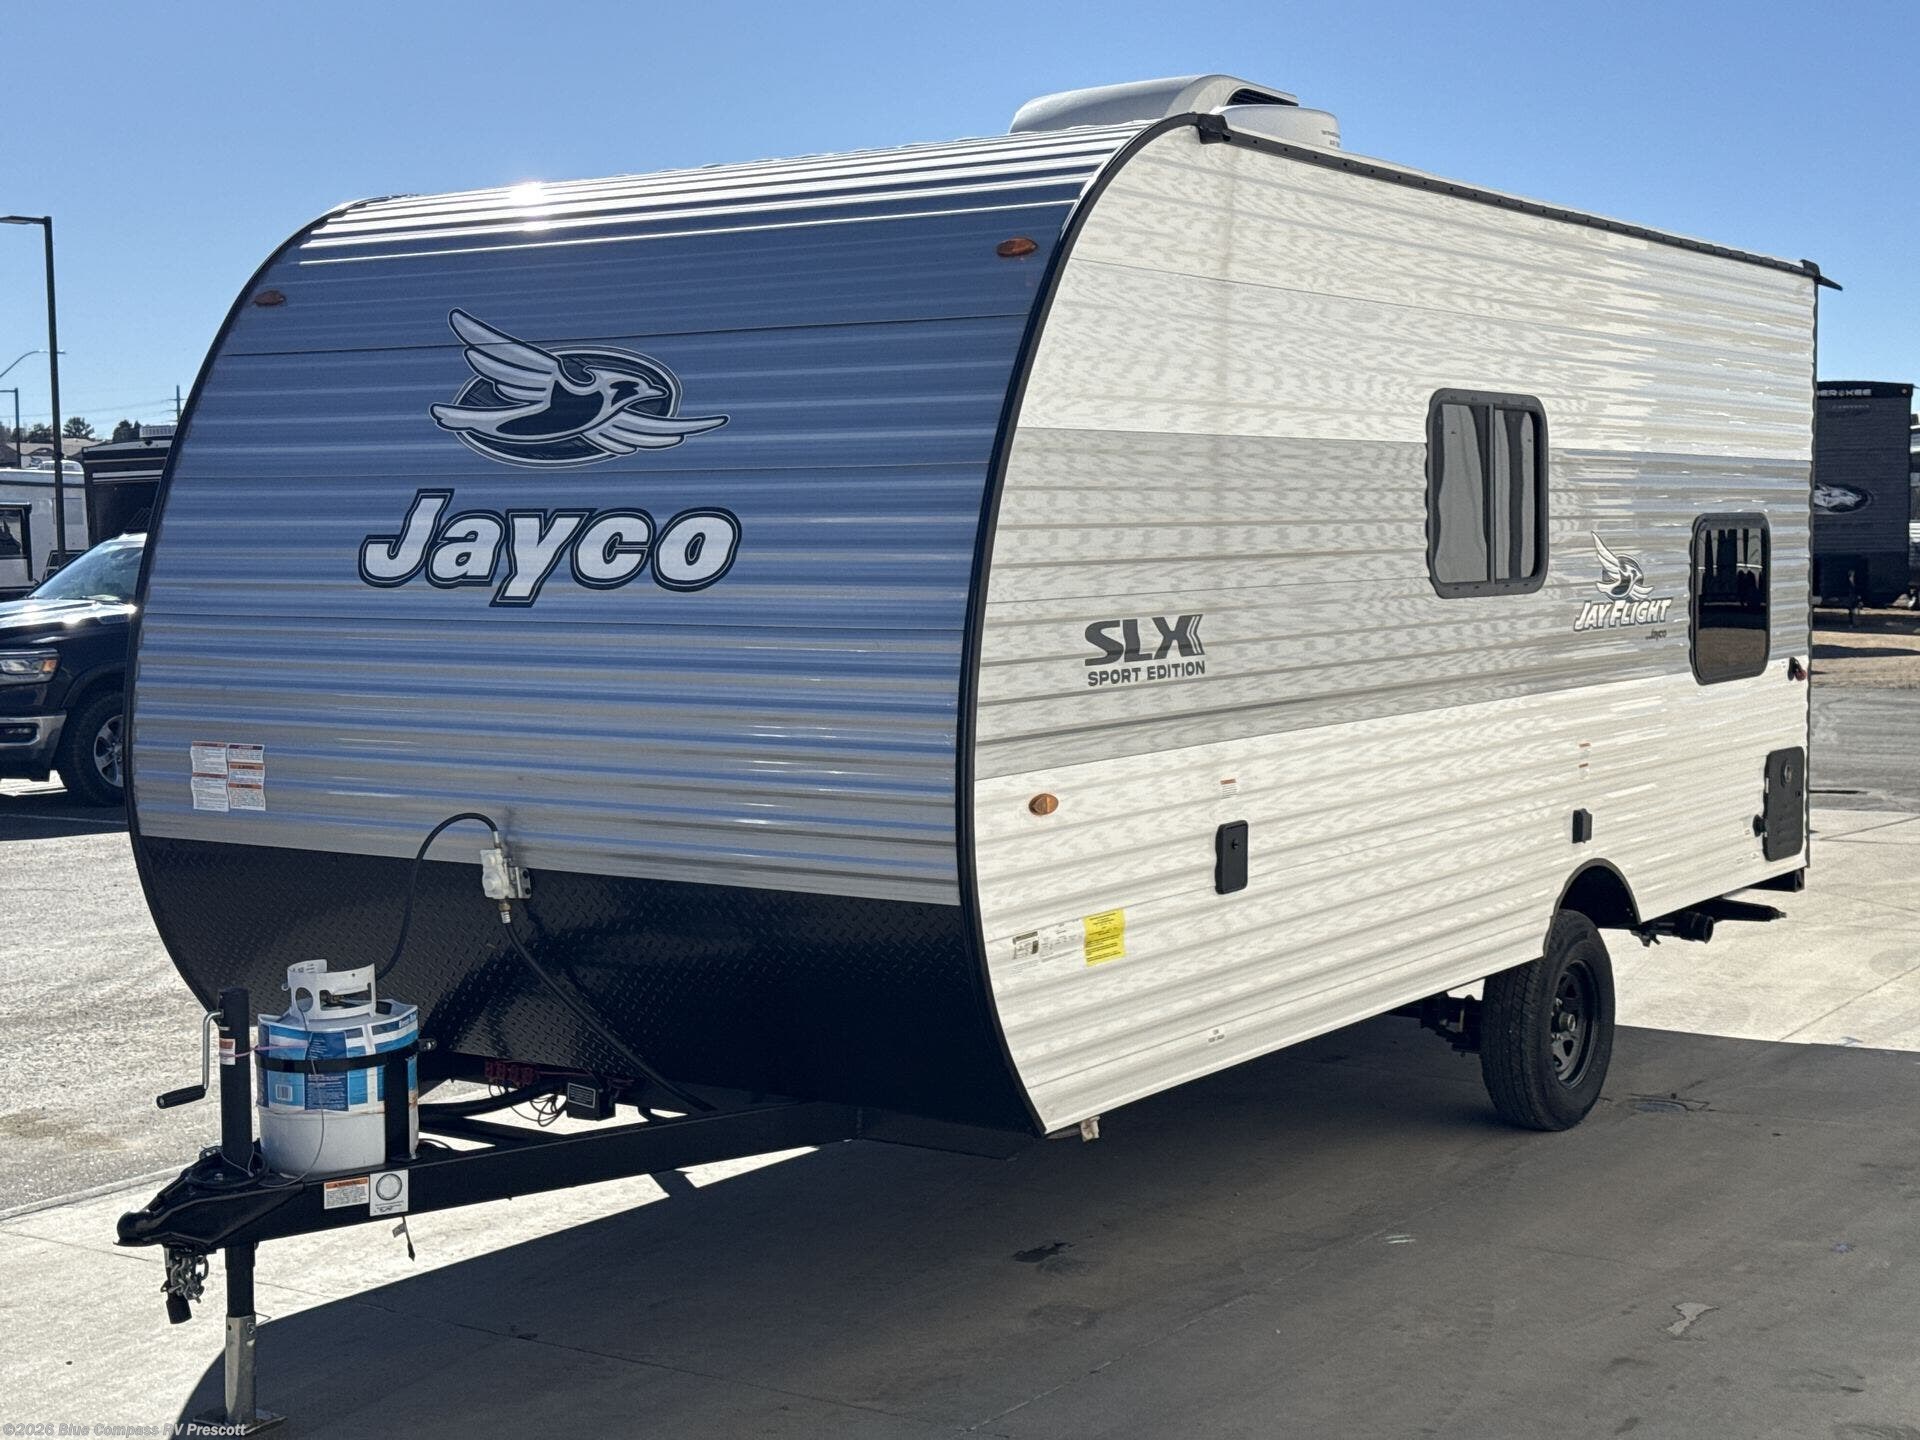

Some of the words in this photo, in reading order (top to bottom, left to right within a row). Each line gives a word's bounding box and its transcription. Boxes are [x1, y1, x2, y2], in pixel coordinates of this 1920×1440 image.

[358, 488, 742, 608] Jayco
[1574, 600, 1613, 632] JAY
[1608, 597, 1674, 628] FLIGHT
[1085, 614, 1206, 666] SLX
[1087, 667, 1142, 687] SPORT
[1146, 661, 1206, 681] EDITION
